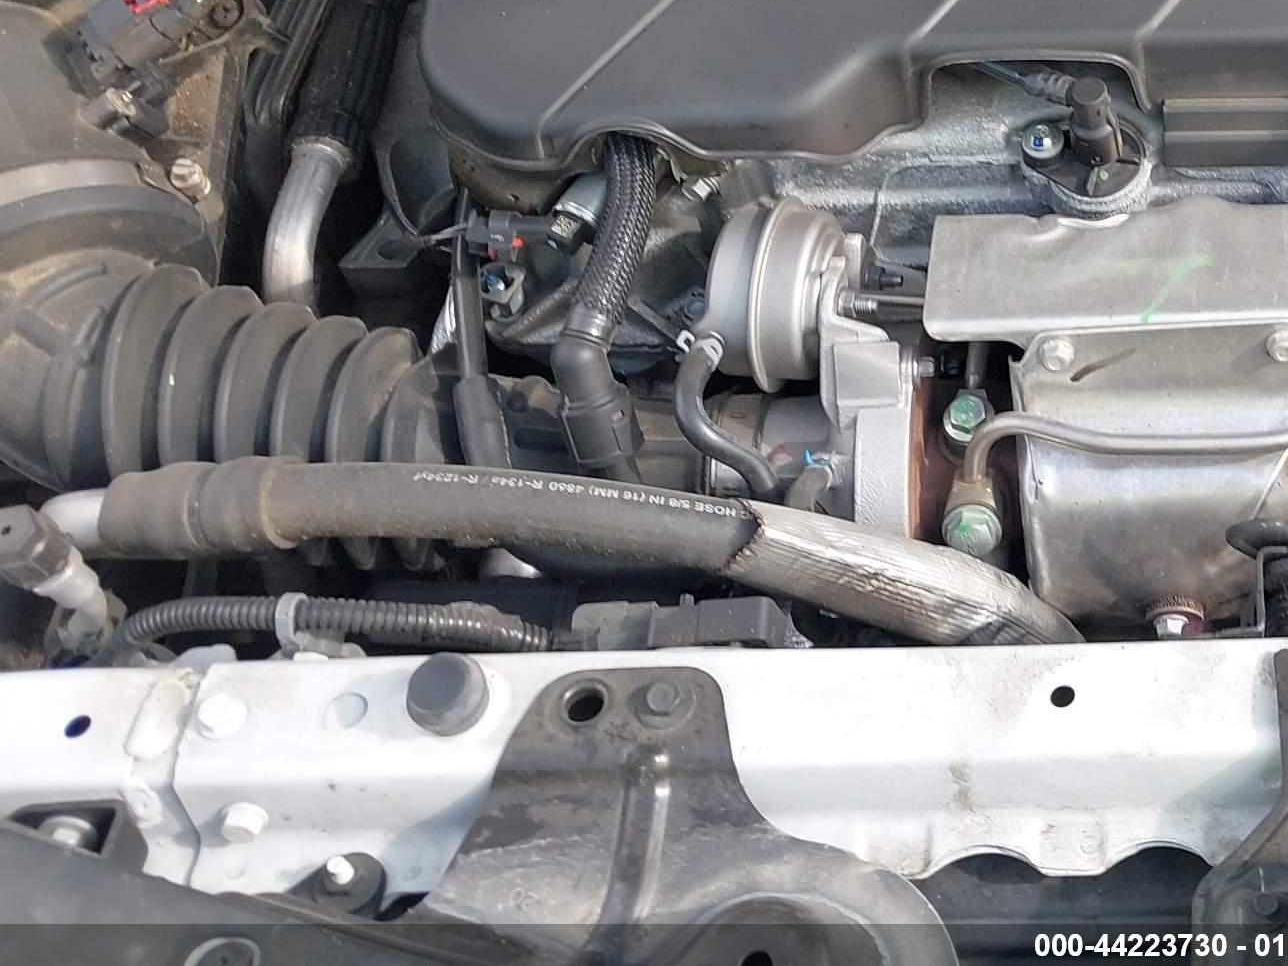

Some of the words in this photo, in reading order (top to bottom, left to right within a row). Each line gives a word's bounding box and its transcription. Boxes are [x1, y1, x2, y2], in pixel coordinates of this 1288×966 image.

[588, 487, 619, 500] MM)
[622, 490, 646, 503] (16
[649, 494, 665, 506] IN
[668, 497, 691, 511] 5/8
[694, 501, 737, 518] HOSE
